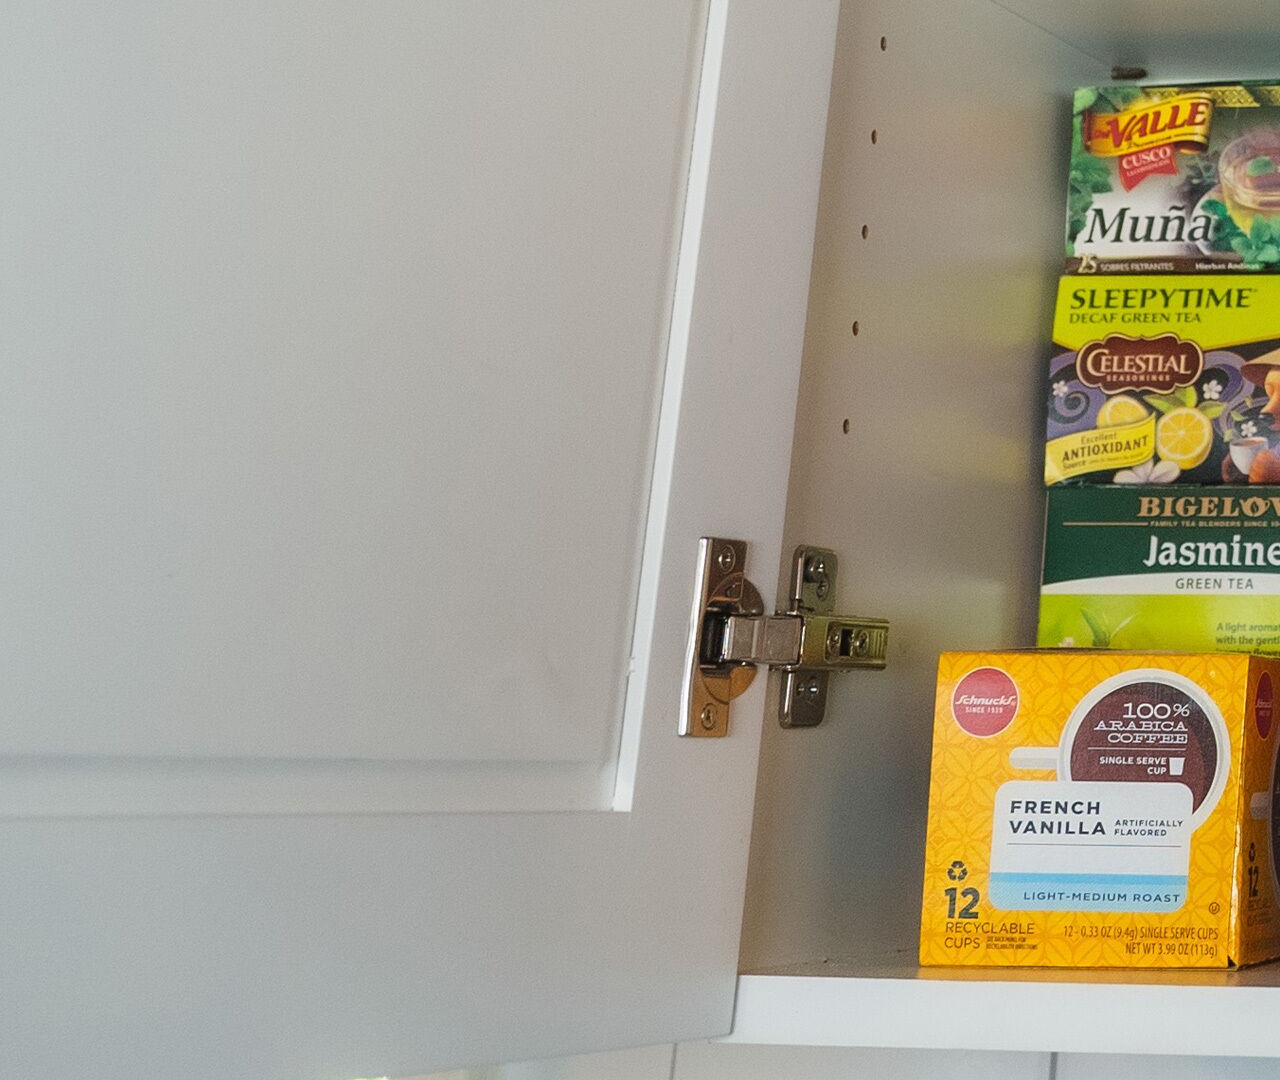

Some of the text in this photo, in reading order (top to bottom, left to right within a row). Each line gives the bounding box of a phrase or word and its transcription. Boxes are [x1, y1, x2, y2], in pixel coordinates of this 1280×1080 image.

[1106, 102, 1210, 148] VALLE
[1122, 146, 1171, 169] CUSCO
[1084, 205, 1213, 244] Muña
[1077, 254, 1097, 273] 25
[1070, 287, 1252, 309] SLEEPYTIME
[1069, 312, 1202, 324] DECAF GREEN TEA
[1086, 348, 1192, 375] CELESTIAL
[1106, 373, 1171, 382] SEASONINGS
[1080, 432, 1117, 445] Excellent
[1062, 435, 1149, 461] ANTIOXIDANT
[1062, 459, 1086, 469] Source
[1181, 520, 1196, 528] TEA
[1175, 577, 1254, 590] GREEN TEA
[1216, 623, 1224, 632] A
[1225, 622, 1247, 633] light
[1216, 635, 1236, 645] with
[1238, 635, 1254, 645] the
[955, 695, 1017, 706] Schnucks
[1122, 702, 1190, 719] 100%
[1093, 720, 1188, 732] ARABICA
[1107, 732, 1188, 744] COFFEE
[1099, 756, 1167, 765] SINGLE SERVE
[1147, 766, 1167, 775] CUP
[1010, 800, 1100, 815] FRENCH
[1009, 820, 1106, 835] VANILLA
[1114, 819, 1183, 828] ARTIFICIALLY
[1114, 828, 1167, 837] FLAVORED
[944, 886, 981, 919] 12
[1023, 891, 1180, 903] LIGHT-MEDIUM ROAST
[945, 921, 1035, 935] RECYCLABLE
[1080, 926, 1219, 941] 0.33 OZ (9.4g) SINGLE SERVE CUPS
[944, 936, 981, 949] CUPS
[1126, 943, 1218, 959] NET WT 3.99 OZ (113g)
